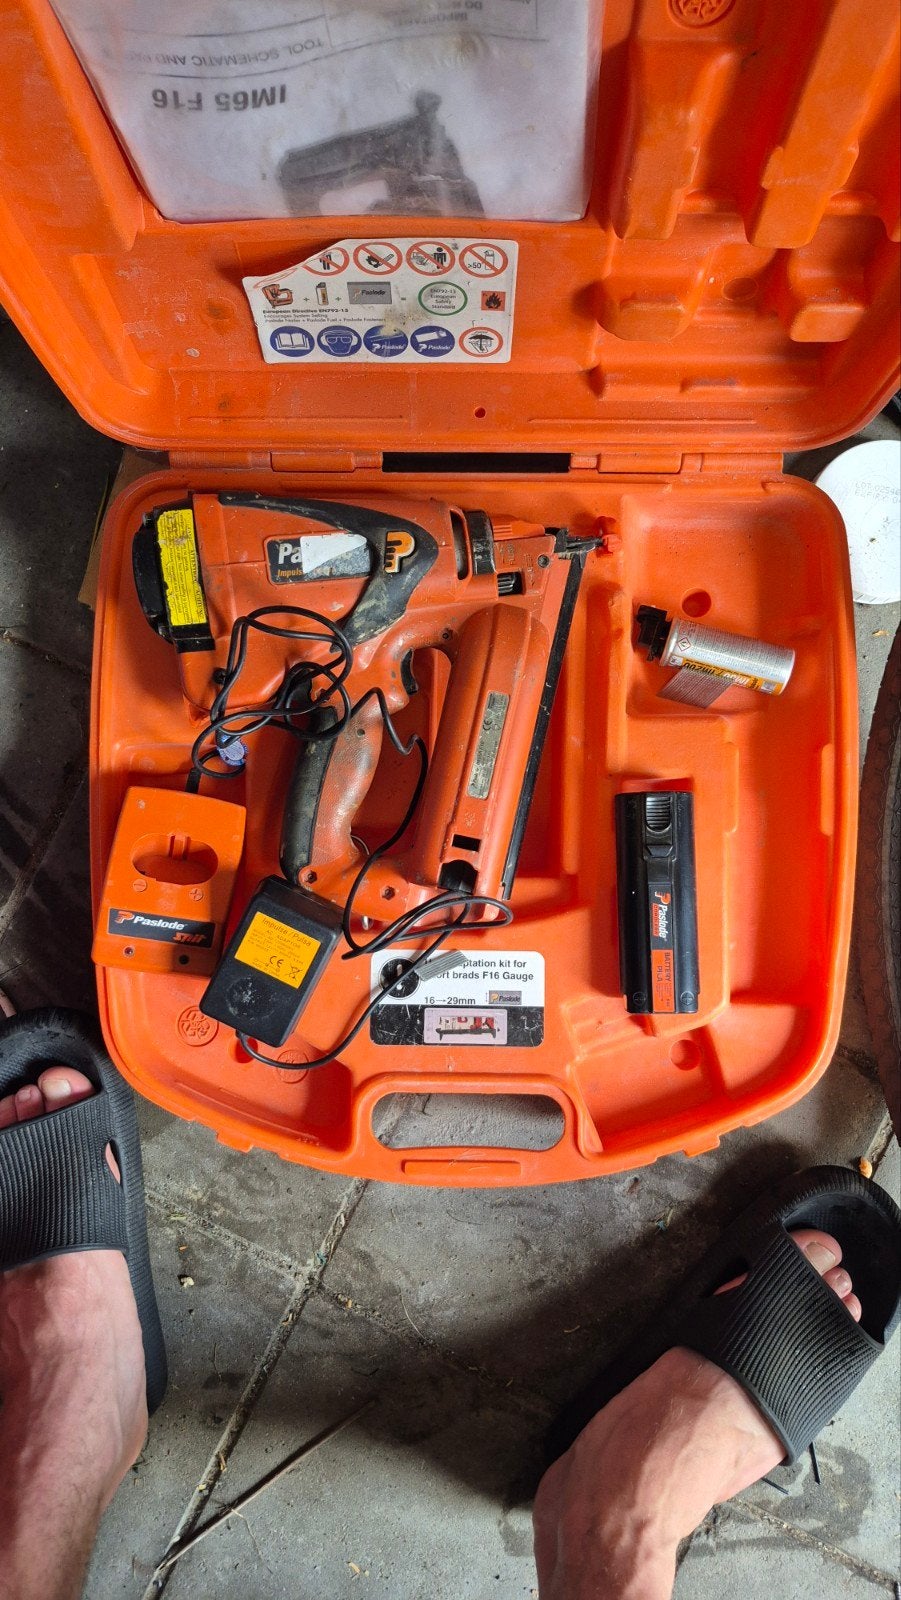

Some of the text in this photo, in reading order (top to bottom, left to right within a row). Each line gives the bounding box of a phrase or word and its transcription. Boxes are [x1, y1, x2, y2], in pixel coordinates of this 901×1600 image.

[286, 38, 324, 54] TOOL
[190, 47, 280, 66] SCHEMATIC
[152, 84, 287, 111] IM65 F16
[277, 568, 303, 578] Impuls
[133, 916, 186, 930] Paslode
[659, 904, 668, 938] Paslode
[459, 960, 496, 968] ptation
[499, 960, 511, 968] kit
[503, 972, 534, 981] Gauge
